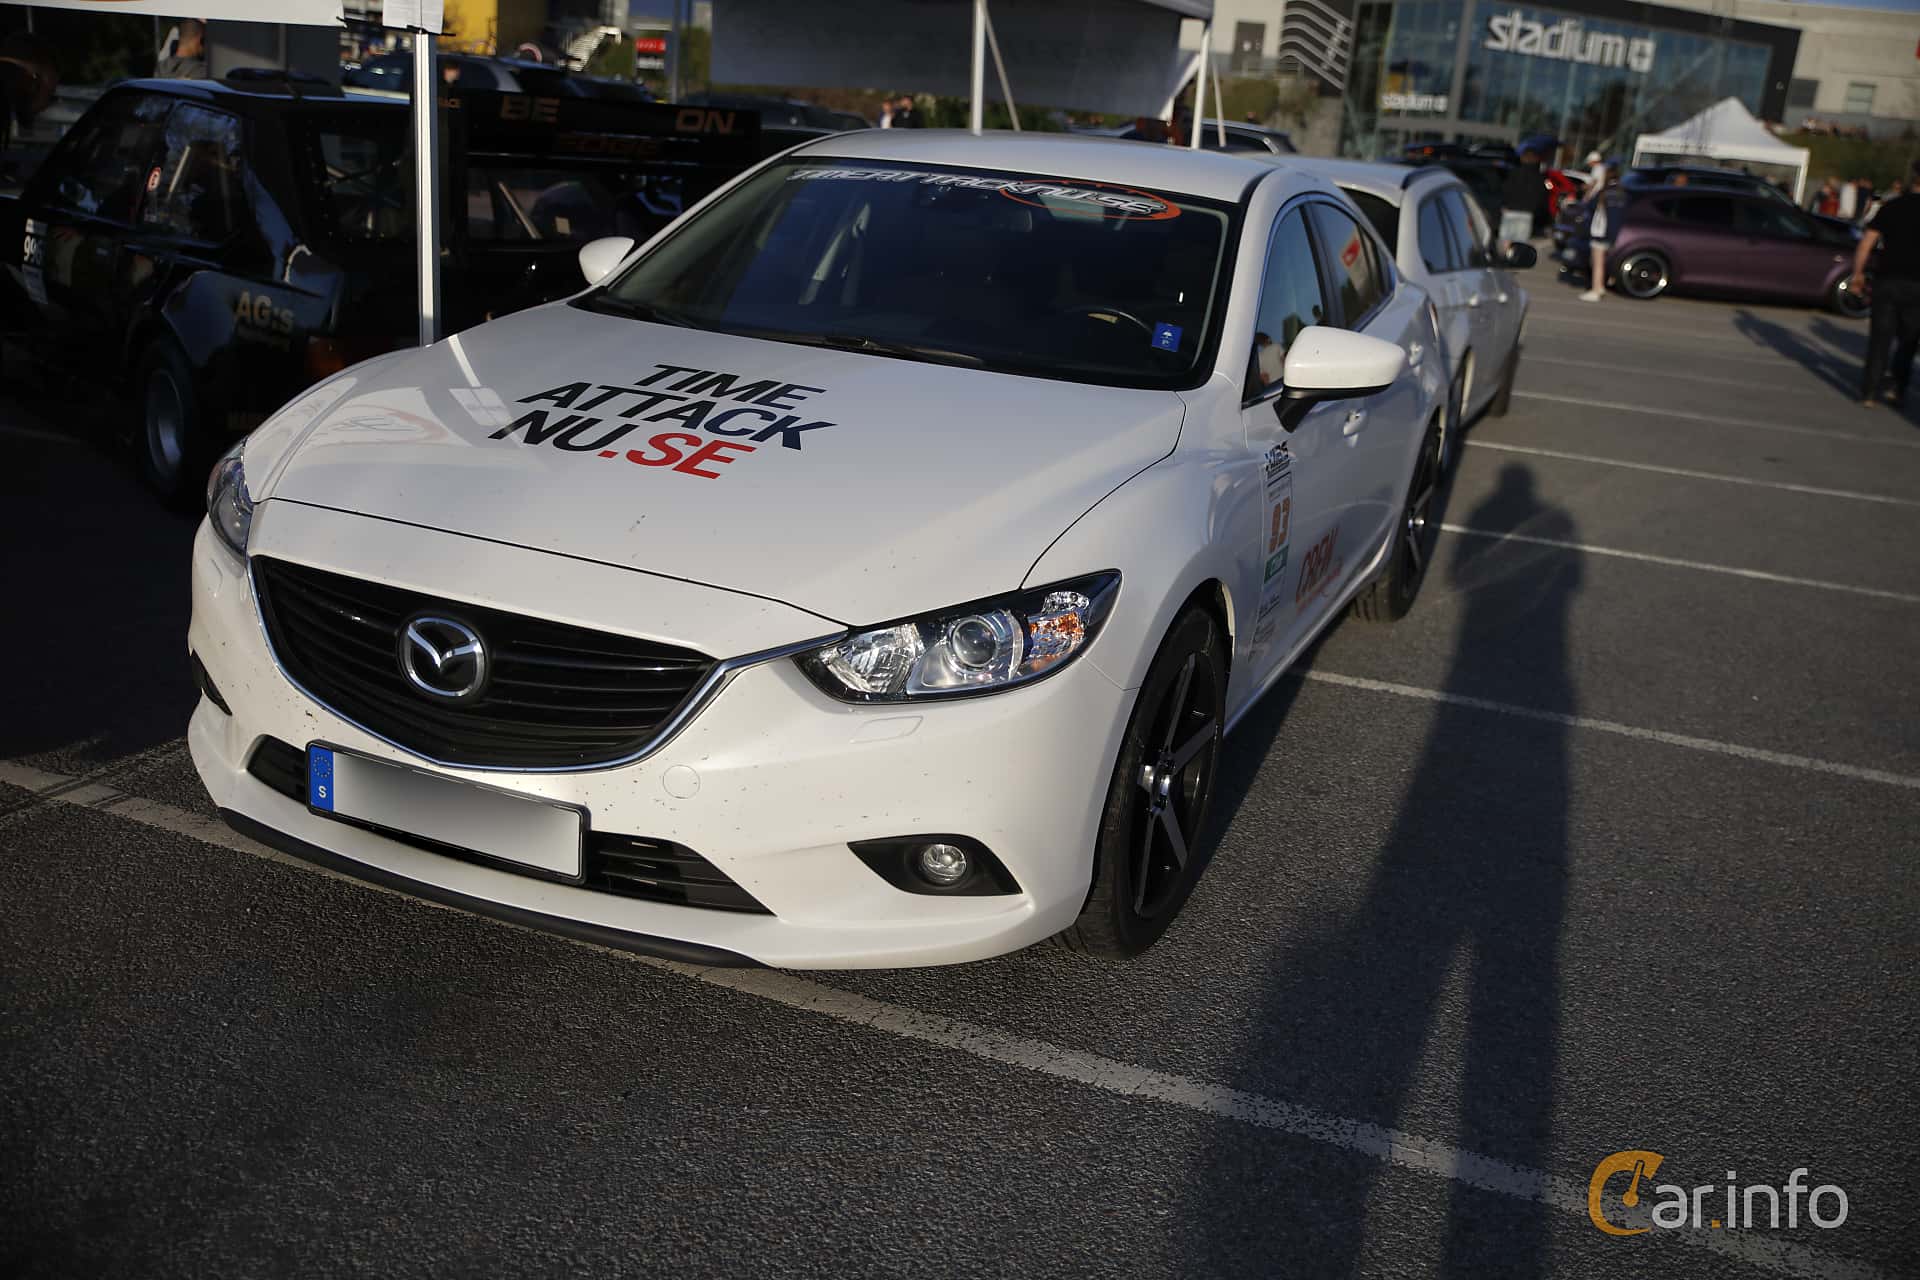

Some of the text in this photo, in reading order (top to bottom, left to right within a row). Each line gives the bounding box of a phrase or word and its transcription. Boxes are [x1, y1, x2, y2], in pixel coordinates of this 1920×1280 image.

[1485, 10, 1629, 67] stadium
[634, 364, 826, 410] TIME
[488, 410, 757, 479] NU.SE
[516, 382, 837, 450] ATTACK
[318, 785, 328, 799] S
